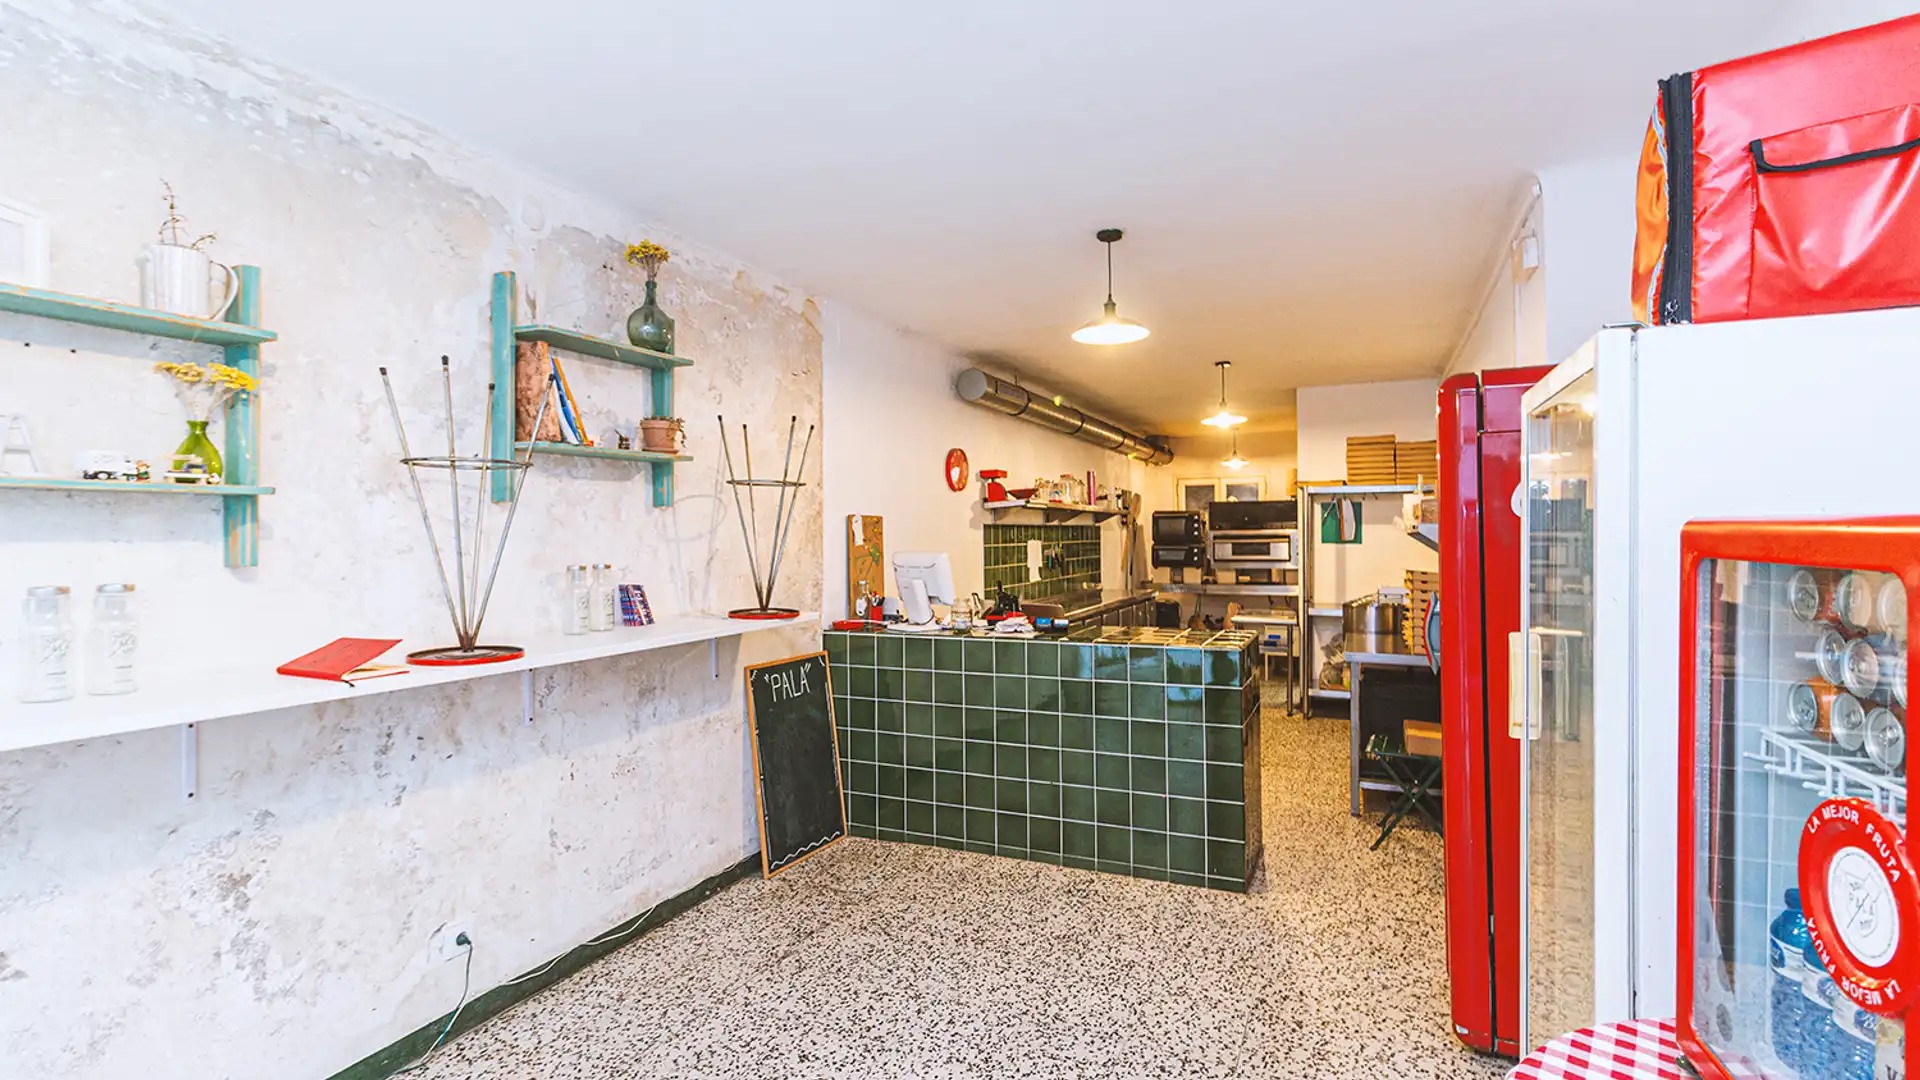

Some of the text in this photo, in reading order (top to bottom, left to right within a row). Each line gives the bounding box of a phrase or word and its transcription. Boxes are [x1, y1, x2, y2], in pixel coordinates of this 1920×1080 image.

[1807, 804, 1901, 883] LA MEJOR FRUTA
[1807, 917, 1836, 974] FRUTA
[1841, 976, 1882, 1005] MEJOR
[1883, 979, 1902, 1000] LA
